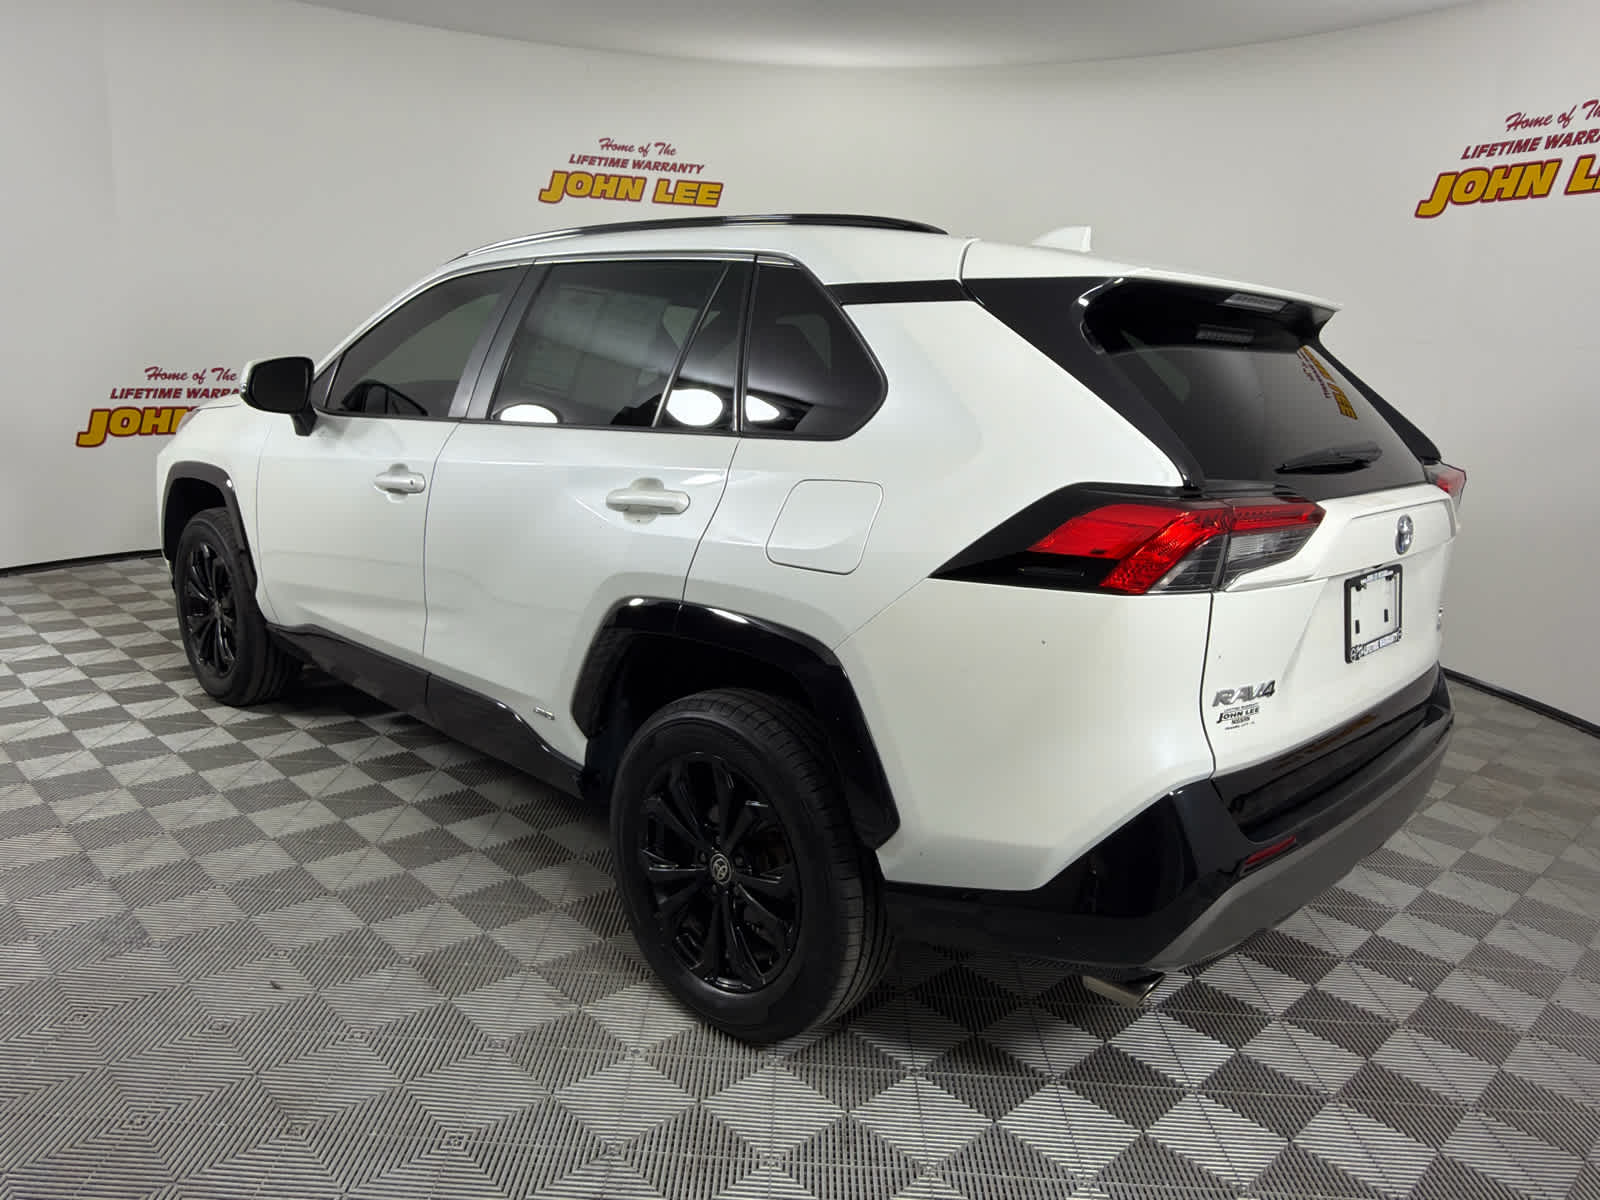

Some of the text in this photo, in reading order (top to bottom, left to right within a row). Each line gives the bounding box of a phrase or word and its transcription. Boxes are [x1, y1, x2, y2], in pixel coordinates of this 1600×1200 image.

[1505, 99, 1600, 132] Home of Th
[598, 137, 677, 157] Home of The
[1460, 136, 1543, 160] LIFETIME
[568, 154, 704, 174] LIFETIME WARRANTY
[538, 170, 724, 208] JOHN LEE
[1415, 158, 1562, 218] JOHN
[144, 366, 237, 384] Home of The
[110, 387, 182, 399] LIFETIME
[1212, 680, 1276, 707] RAV4
